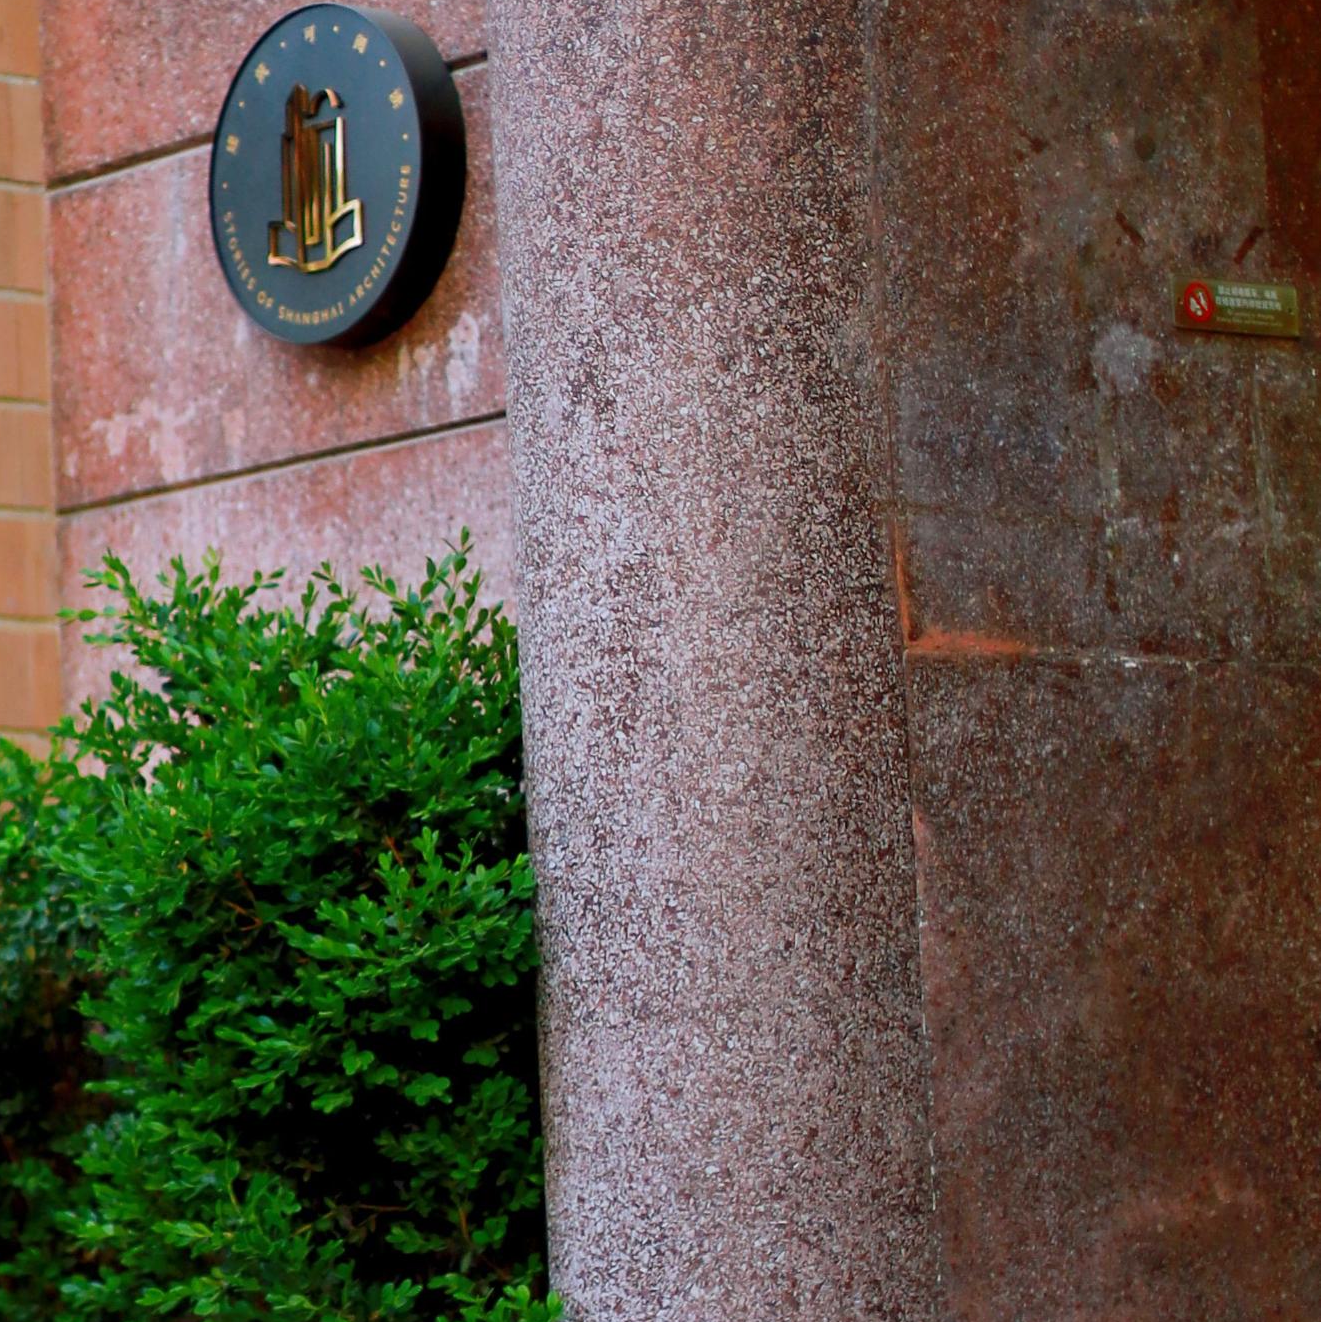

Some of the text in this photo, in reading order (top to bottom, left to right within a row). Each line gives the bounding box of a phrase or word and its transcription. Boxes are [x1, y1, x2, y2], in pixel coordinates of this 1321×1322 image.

[223, 164, 412, 326] STORIES OF SHANGHAI ARCHITECTURE
